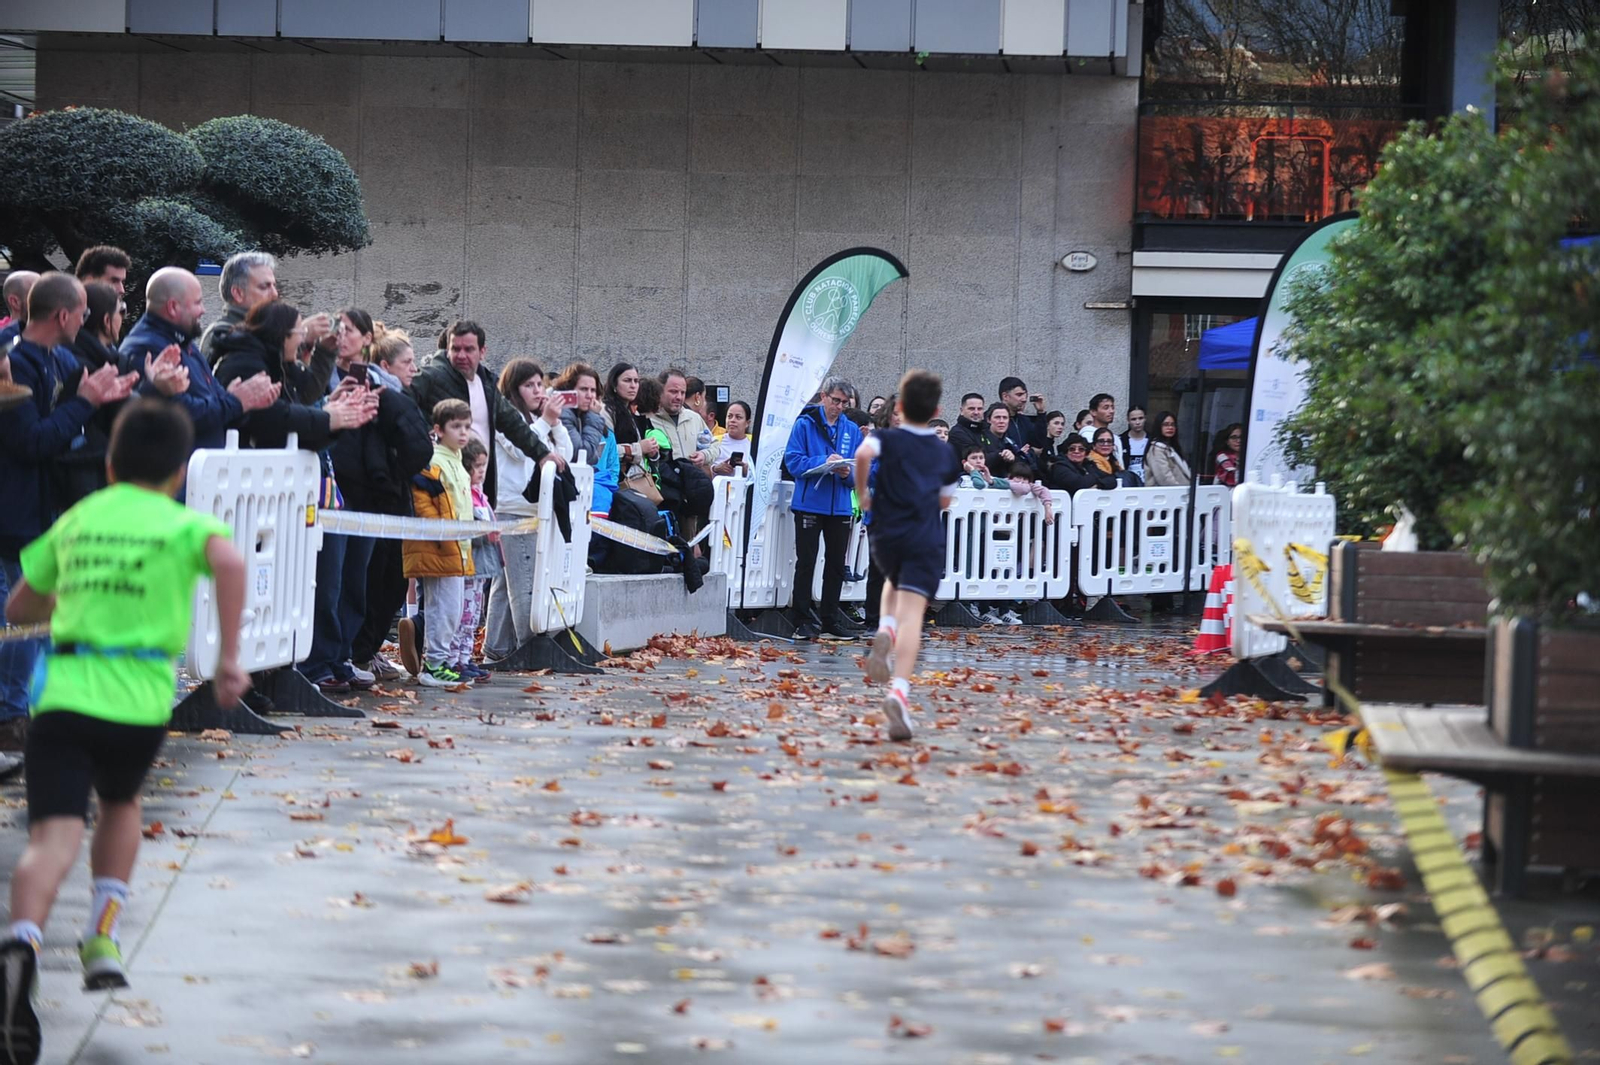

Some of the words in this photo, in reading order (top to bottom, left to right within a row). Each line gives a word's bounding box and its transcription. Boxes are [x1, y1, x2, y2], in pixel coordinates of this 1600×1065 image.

[805, 291, 817, 315] CLUB
[814, 279, 854, 295] NATACION
[760, 469, 768, 493] CLUB
